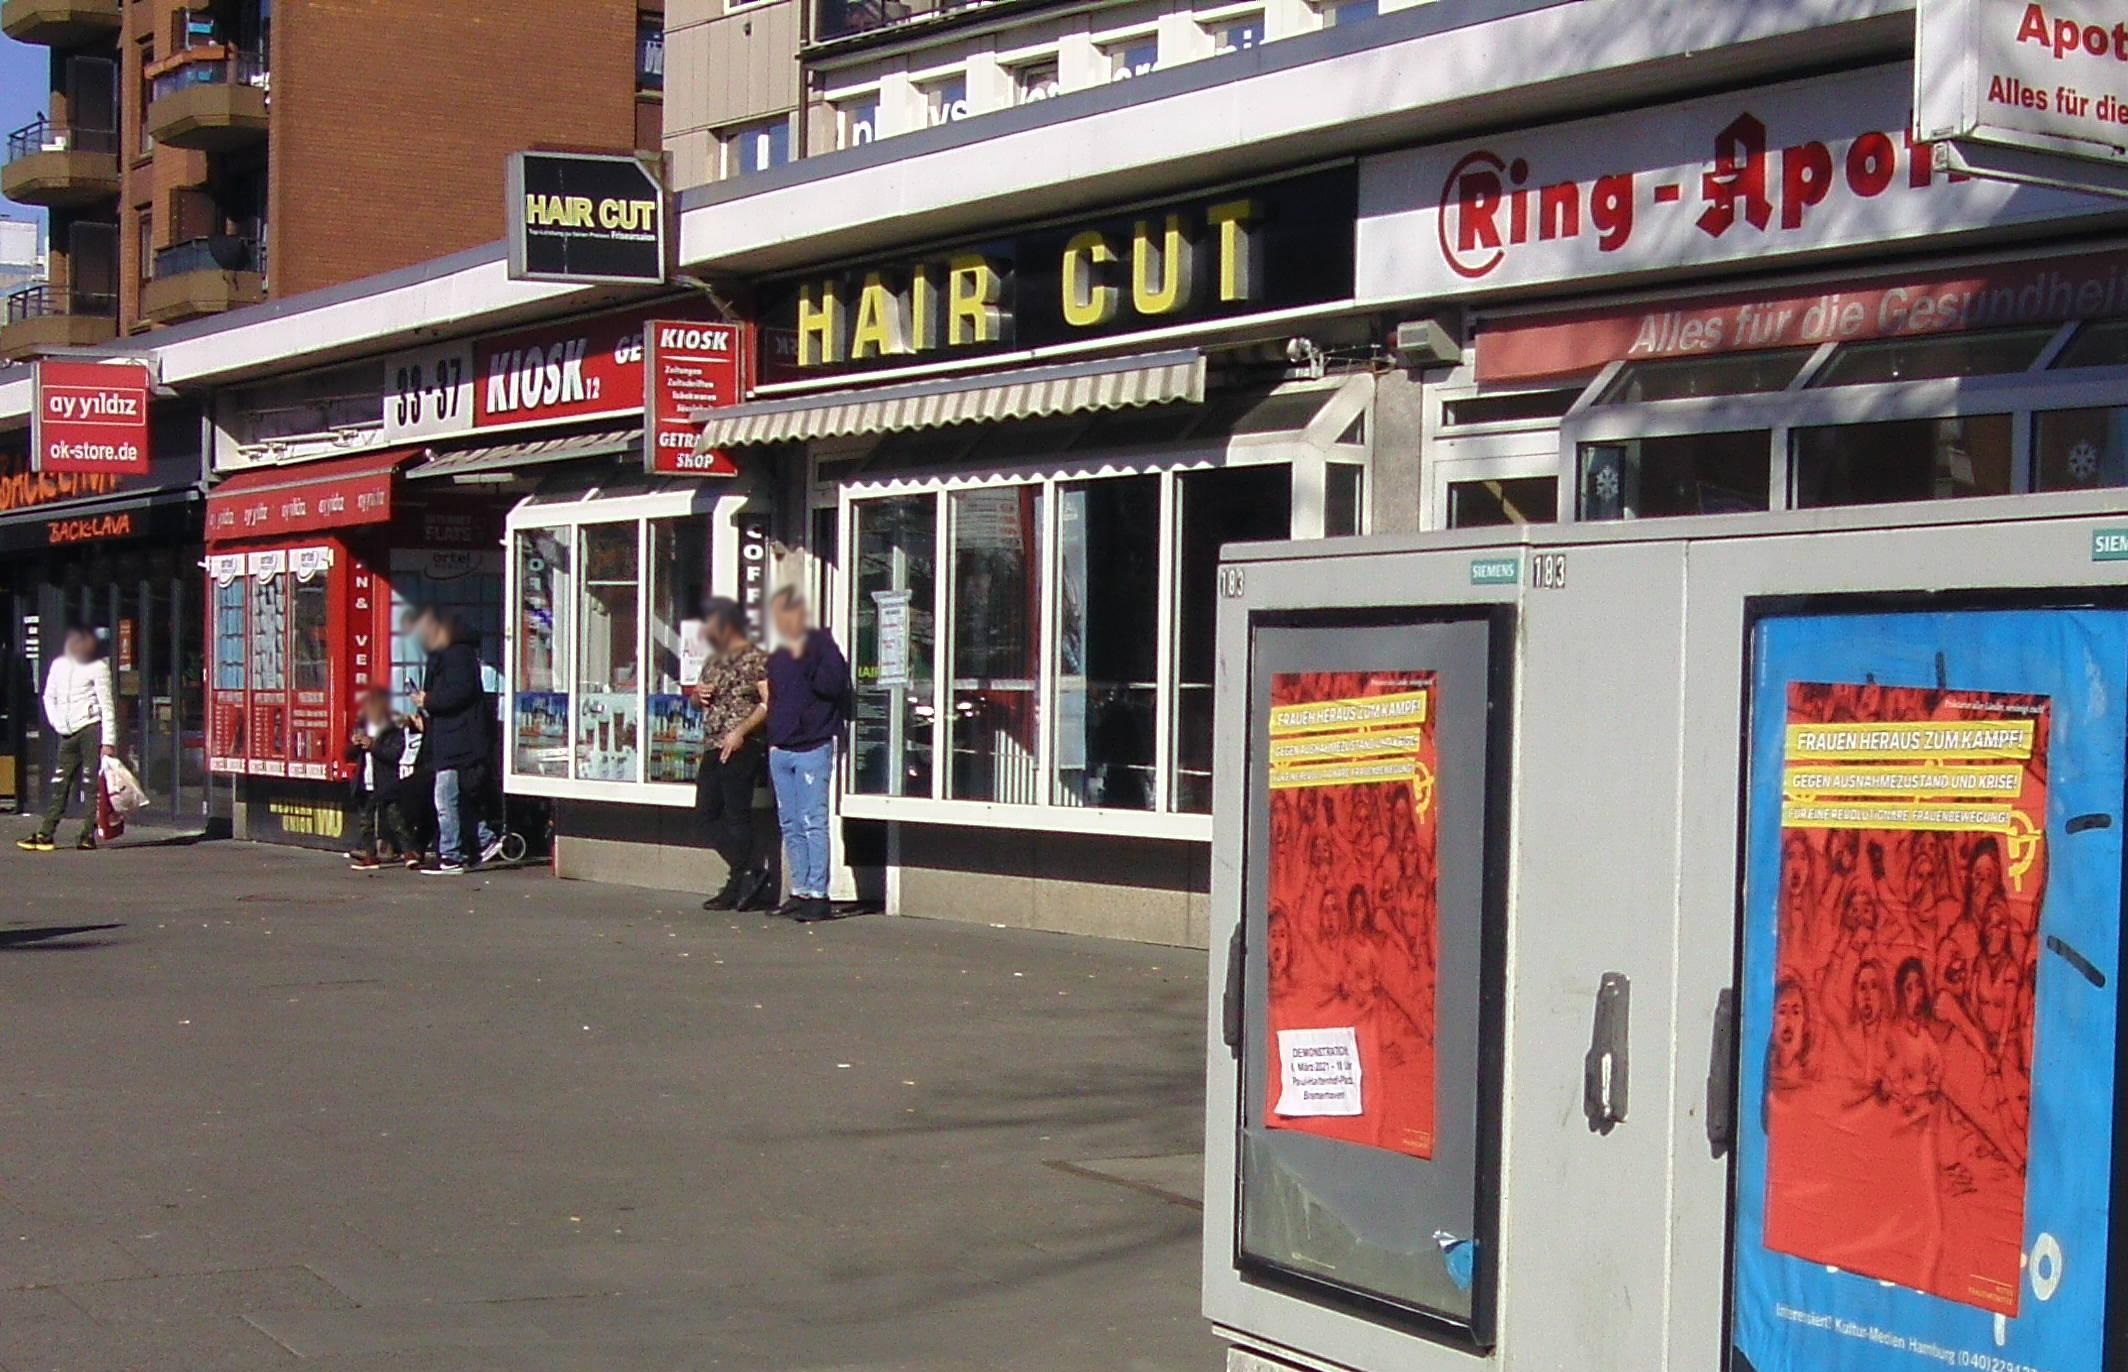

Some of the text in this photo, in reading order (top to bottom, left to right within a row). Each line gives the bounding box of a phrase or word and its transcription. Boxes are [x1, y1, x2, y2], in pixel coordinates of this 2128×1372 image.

[1987, 75, 2048, 111] Alles
[2056, 86, 2089, 117] für
[526, 194, 656, 231] HAIR CUT
[797, 199, 1255, 367] HAIR CUT
[1628, 314, 1724, 354] Alles
[1735, 301, 1795, 345] für
[1800, 293, 1865, 339] die
[660, 328, 729, 351] KIOSK
[486, 337, 600, 414] KIOSK 12
[50, 396, 76, 419] ay
[50, 440, 138, 462] ok-store.de
[1221, 568, 1245, 597] 183
[1472, 562, 1514, 578] SIEMENS
[1534, 554, 1566, 588] 183
[1797, 730, 2023, 751] FRAUEN HERAUS ZUM KAMPF!
[1793, 774, 2018, 789] GEGEN AUSNAHMEZUSTAND UND KRISE!
[1912, 810, 2009, 823] FRAUENBEWEGUNG!
